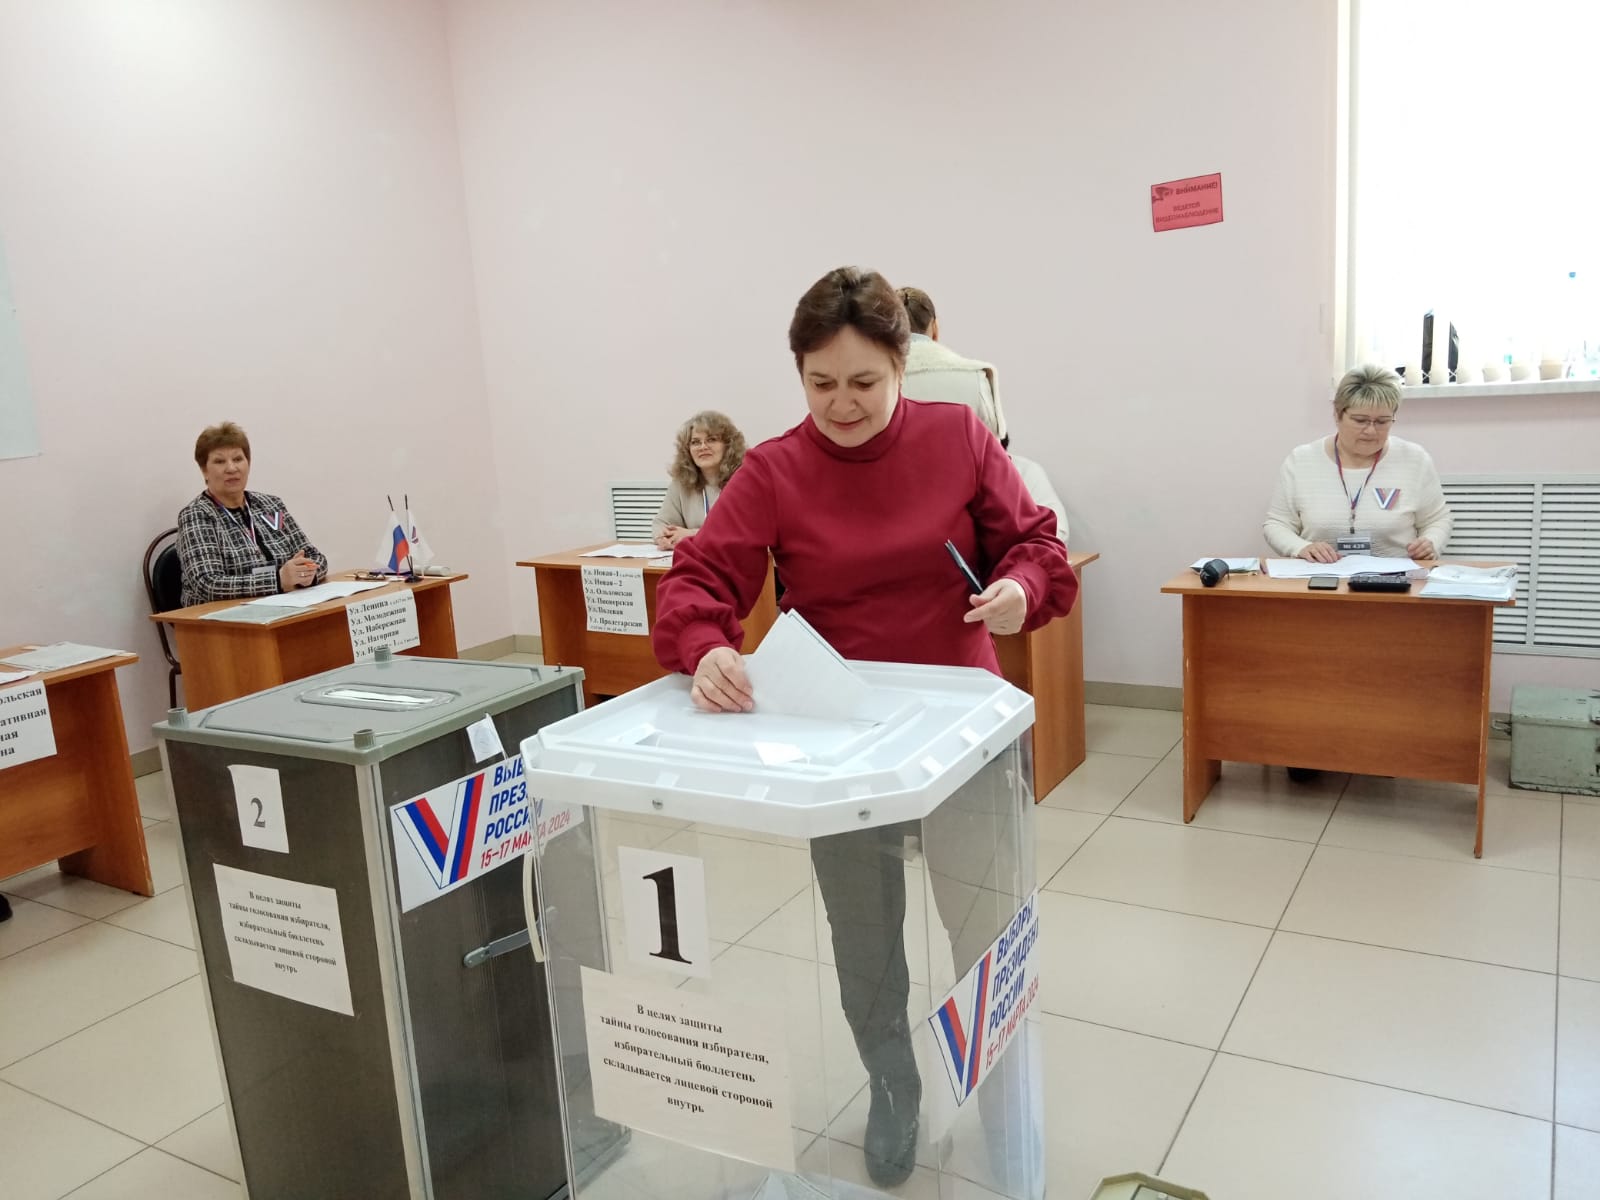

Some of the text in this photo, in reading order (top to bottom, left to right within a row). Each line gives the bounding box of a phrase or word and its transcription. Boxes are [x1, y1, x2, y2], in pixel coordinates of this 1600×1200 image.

[1176, 182, 1217, 195] ВНИМАНИЕ!
[361, 600, 388, 612] Ленина
[366, 618, 406, 633] Набережная
[367, 630, 399, 644] Нагорная
[250, 798, 266, 828] 2
[489, 781, 528, 816] ПРЕЗ
[548, 808, 570, 834] 2024
[229, 902, 248, 912] тайны
[250, 907, 289, 921] голосования
[249, 891, 301, 909] В целях защиты
[642, 866, 692, 964] 1
[239, 921, 324, 946] избирательный бюллетень
[996, 895, 1033, 965] ВЫБОРЫ
[234, 935, 336, 966] складывается лицевой стороной
[274, 962, 298, 973] внутрь
[988, 968, 1025, 1038] РОССИИ
[637, 1004, 722, 1033] В целях защиты
[1005, 995, 1025, 1042] МАРТА
[600, 1015, 769, 1064] тайны голосования избирателя,
[614, 1040, 756, 1083] избирательный бюллетень
[603, 1056, 773, 1110] складывается лицевой стороной
[667, 1096, 704, 1113] внутрь
